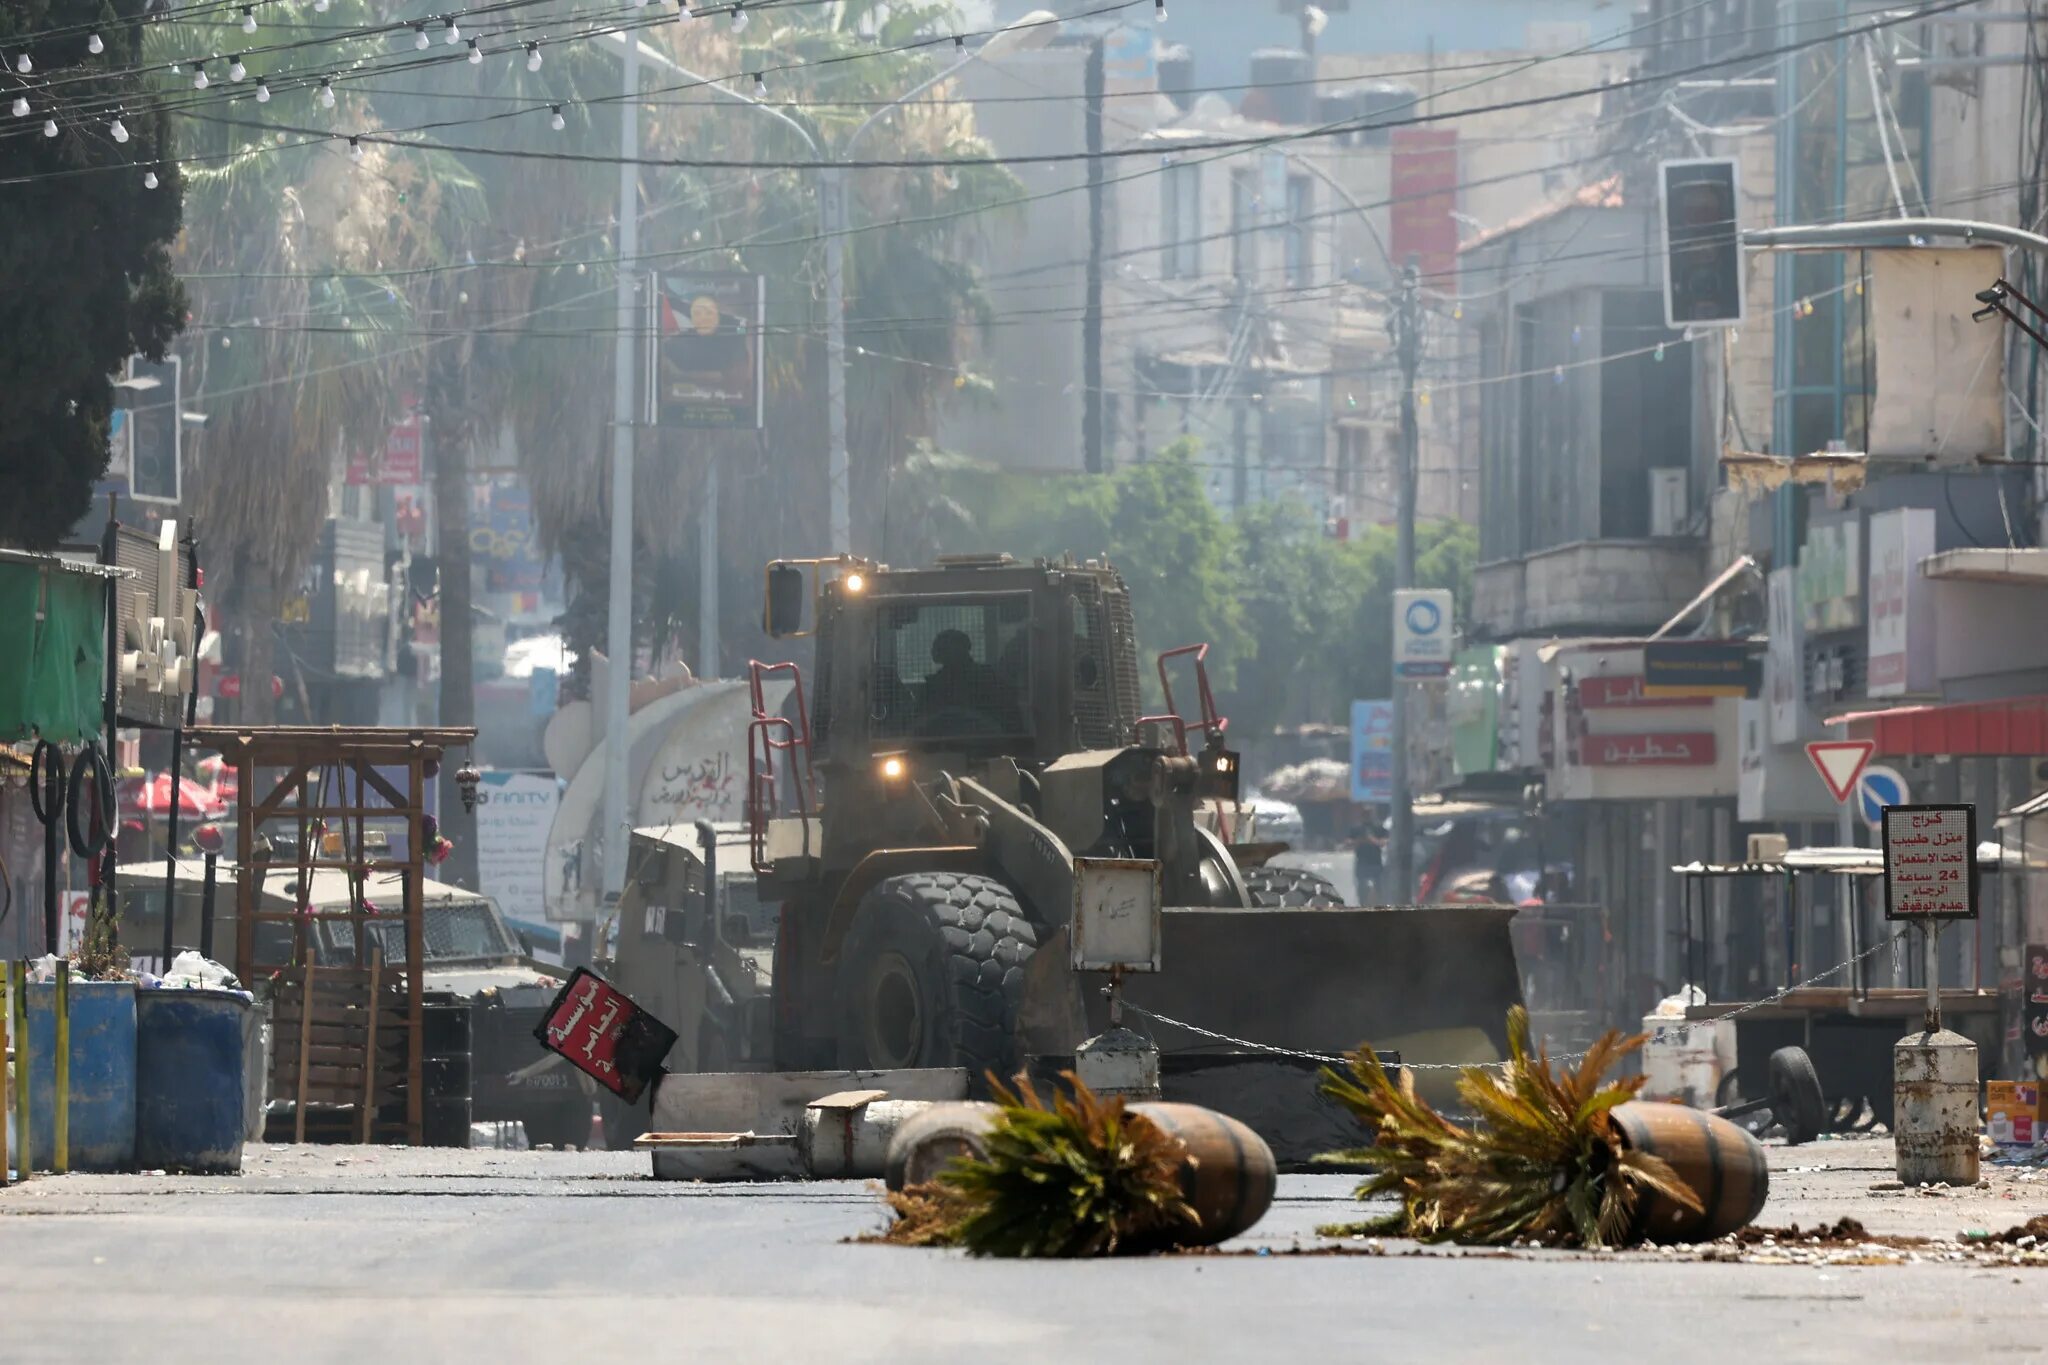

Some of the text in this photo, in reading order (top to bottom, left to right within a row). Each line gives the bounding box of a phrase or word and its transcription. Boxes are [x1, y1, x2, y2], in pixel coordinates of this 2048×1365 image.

[1604, 736, 1691, 762] حطين
[1912, 812, 1943, 828] كراج
[1892, 832, 1963, 848] منزل طبيب
[1941, 852, 1963, 863] تحت
[1896, 870, 1959, 882] 24 ساعة
[1913, 885, 1948, 897] الرجاء
[1896, 899, 1964, 912] عدم الوقوف
[547, 980, 600, 1042] مؤسسة
[582, 996, 621, 1060] العامر
